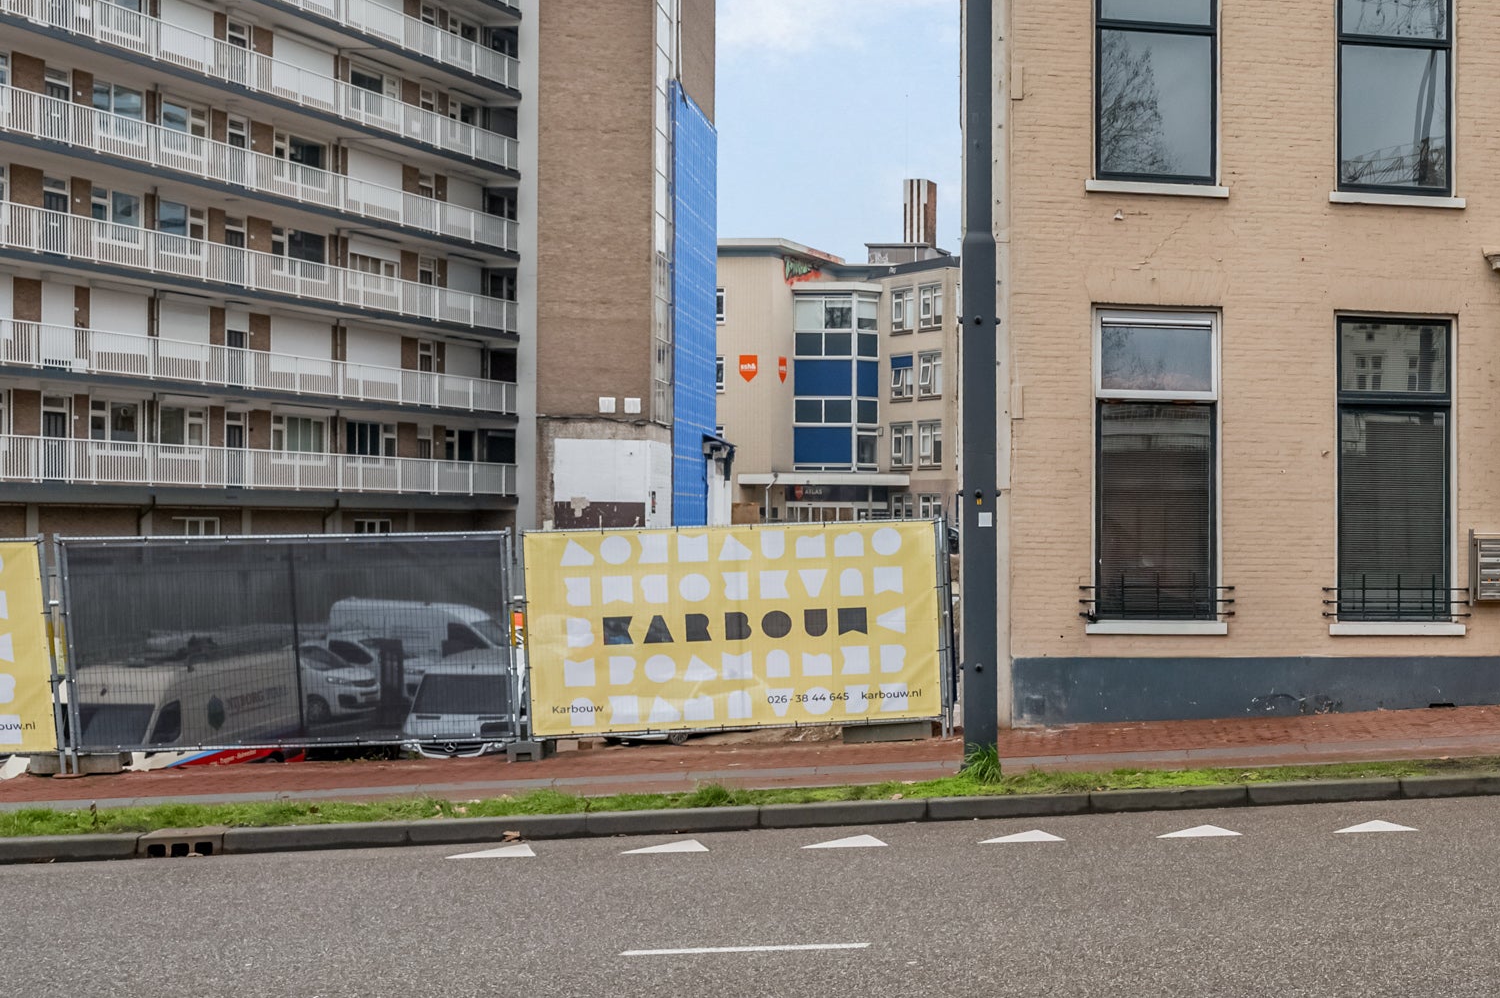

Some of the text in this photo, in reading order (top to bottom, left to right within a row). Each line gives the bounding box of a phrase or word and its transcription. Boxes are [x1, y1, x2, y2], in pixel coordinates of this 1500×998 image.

[602, 607, 868, 646] KARBOUW
[767, 695, 788, 704] 026
[795, 694, 809, 703] 38
[811, 693, 827, 702] 44
[829, 692, 850, 701] 645
[861, 689, 922, 700] karbouw.nl
[552, 704, 604, 714] Karbouw
